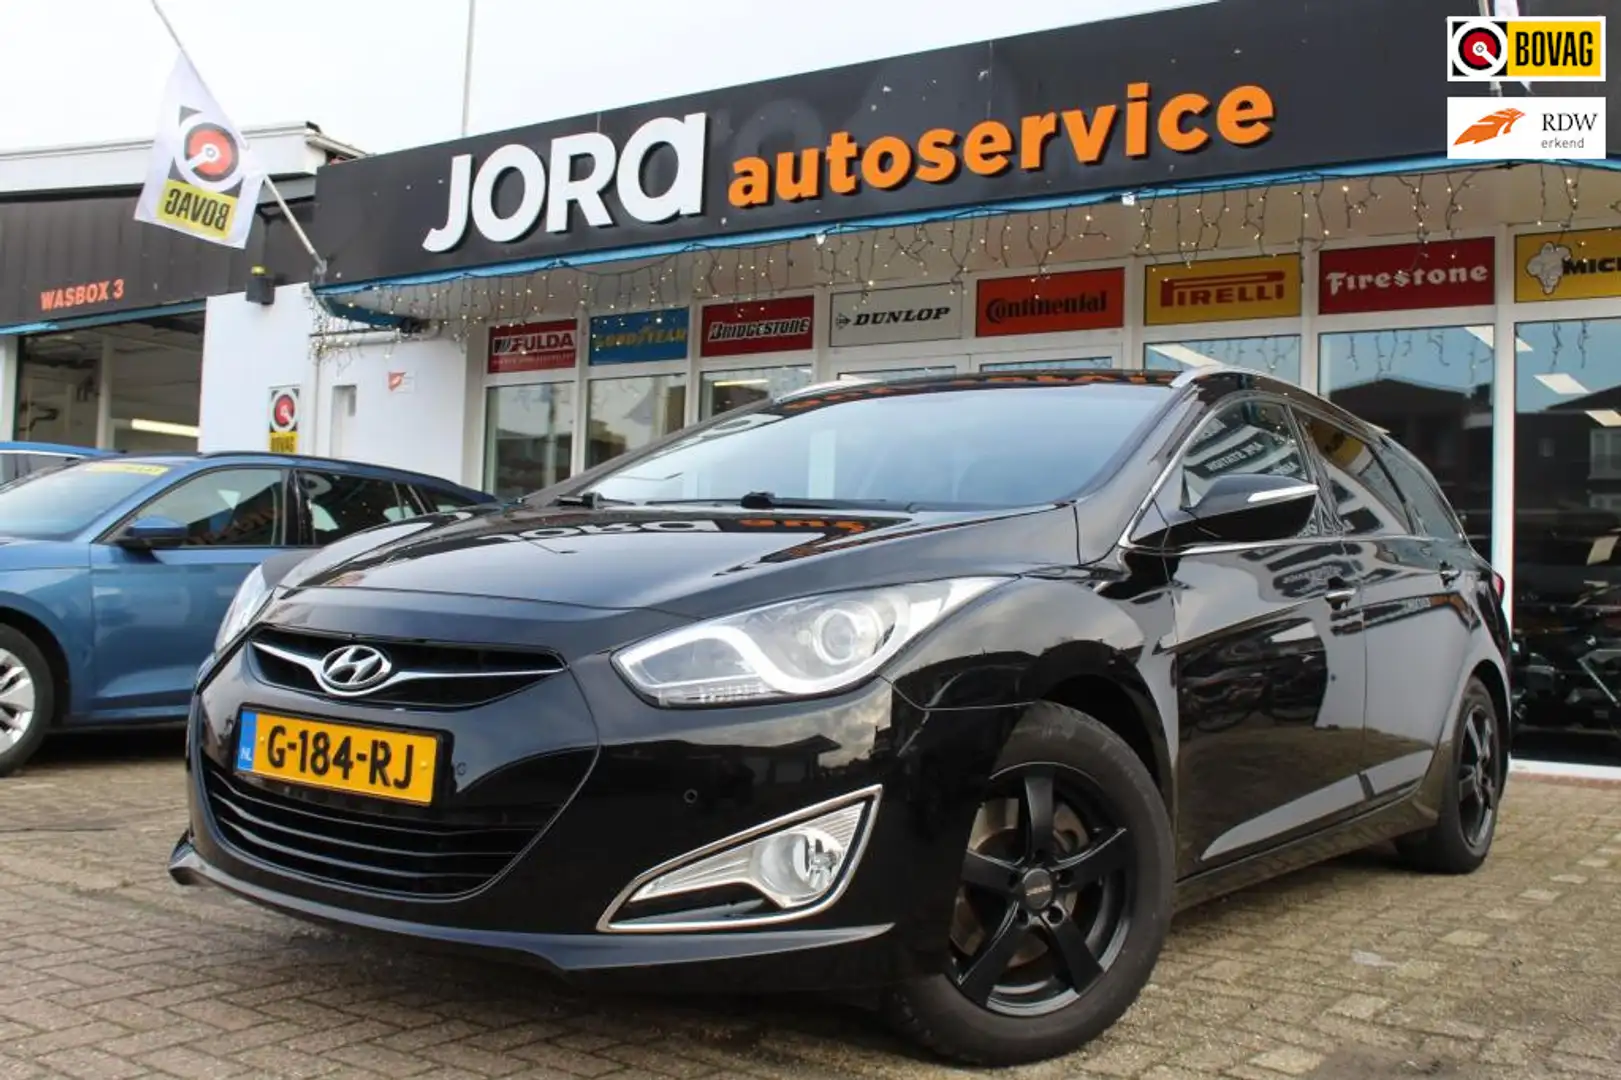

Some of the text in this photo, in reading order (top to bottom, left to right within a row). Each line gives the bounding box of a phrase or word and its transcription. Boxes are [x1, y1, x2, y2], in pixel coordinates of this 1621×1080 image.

[728, 82, 1274, 207] autoservice
[40, 278, 125, 311] WASBOX 3
[1160, 271, 1285, 307] PIRELLI
[1326, 265, 1489, 296] Firestone
[853, 307, 950, 326] DUNLOP
[985, 291, 1107, 324] Continental
[511, 332, 574, 353] FULDA
[708, 317, 811, 342] BRIDGESTONE
[267, 725, 414, 790] G-184-RJ
